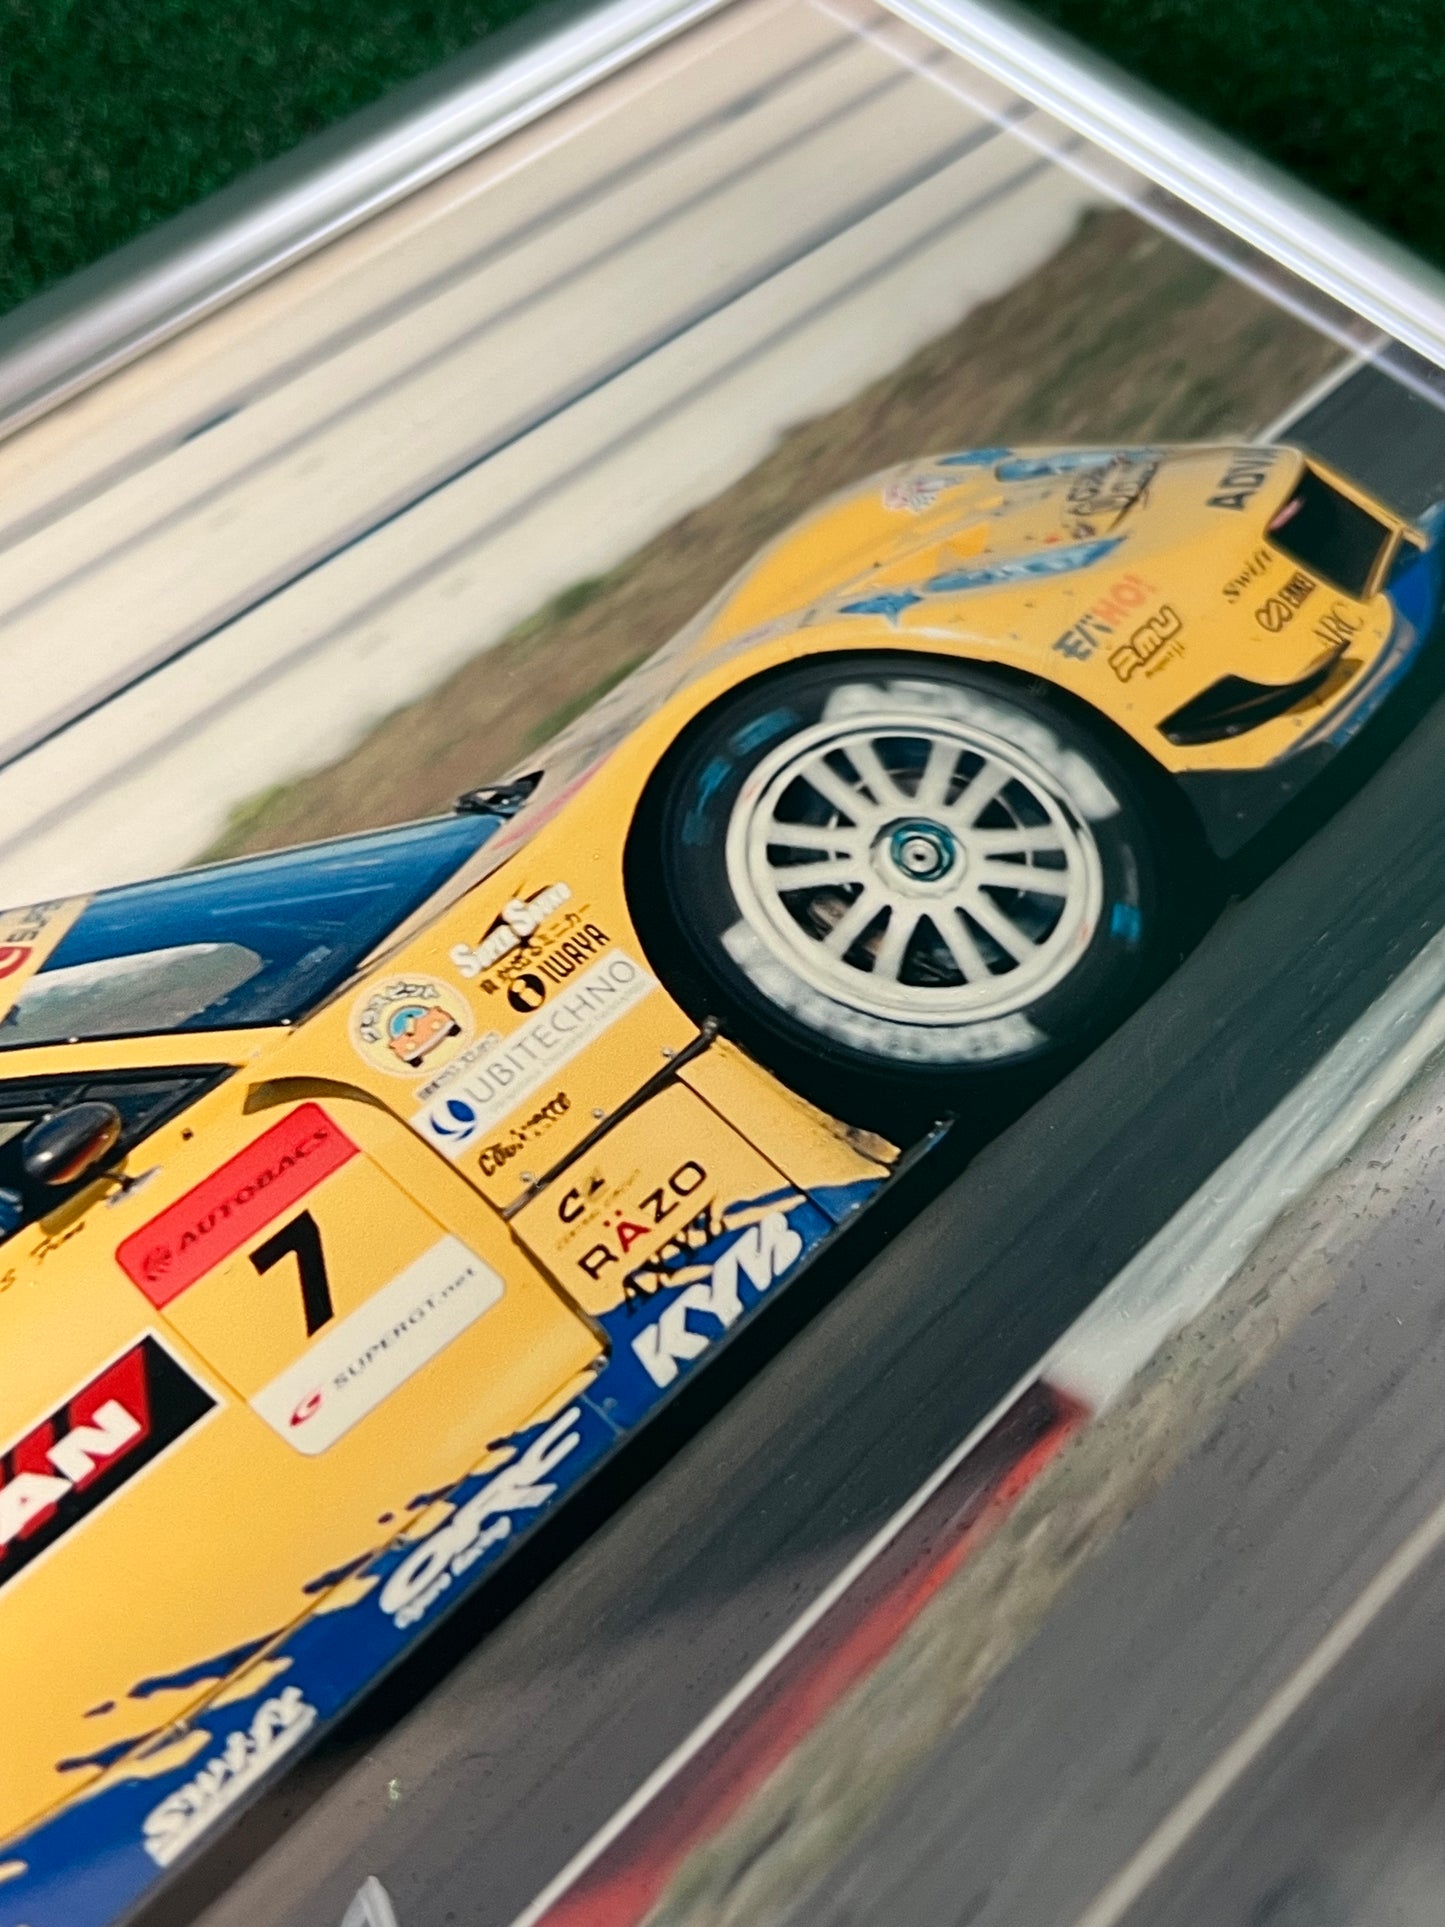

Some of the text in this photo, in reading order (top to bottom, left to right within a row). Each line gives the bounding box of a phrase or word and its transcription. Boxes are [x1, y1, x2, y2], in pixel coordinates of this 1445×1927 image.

[536, 922, 611, 984] IWAYA
[466, 959, 636, 1105] UBITECHNO
[179, 1127, 329, 1252] AUTOBACS
[249, 1208, 335, 1338] 7
[630, 1211, 803, 1388] KYB
